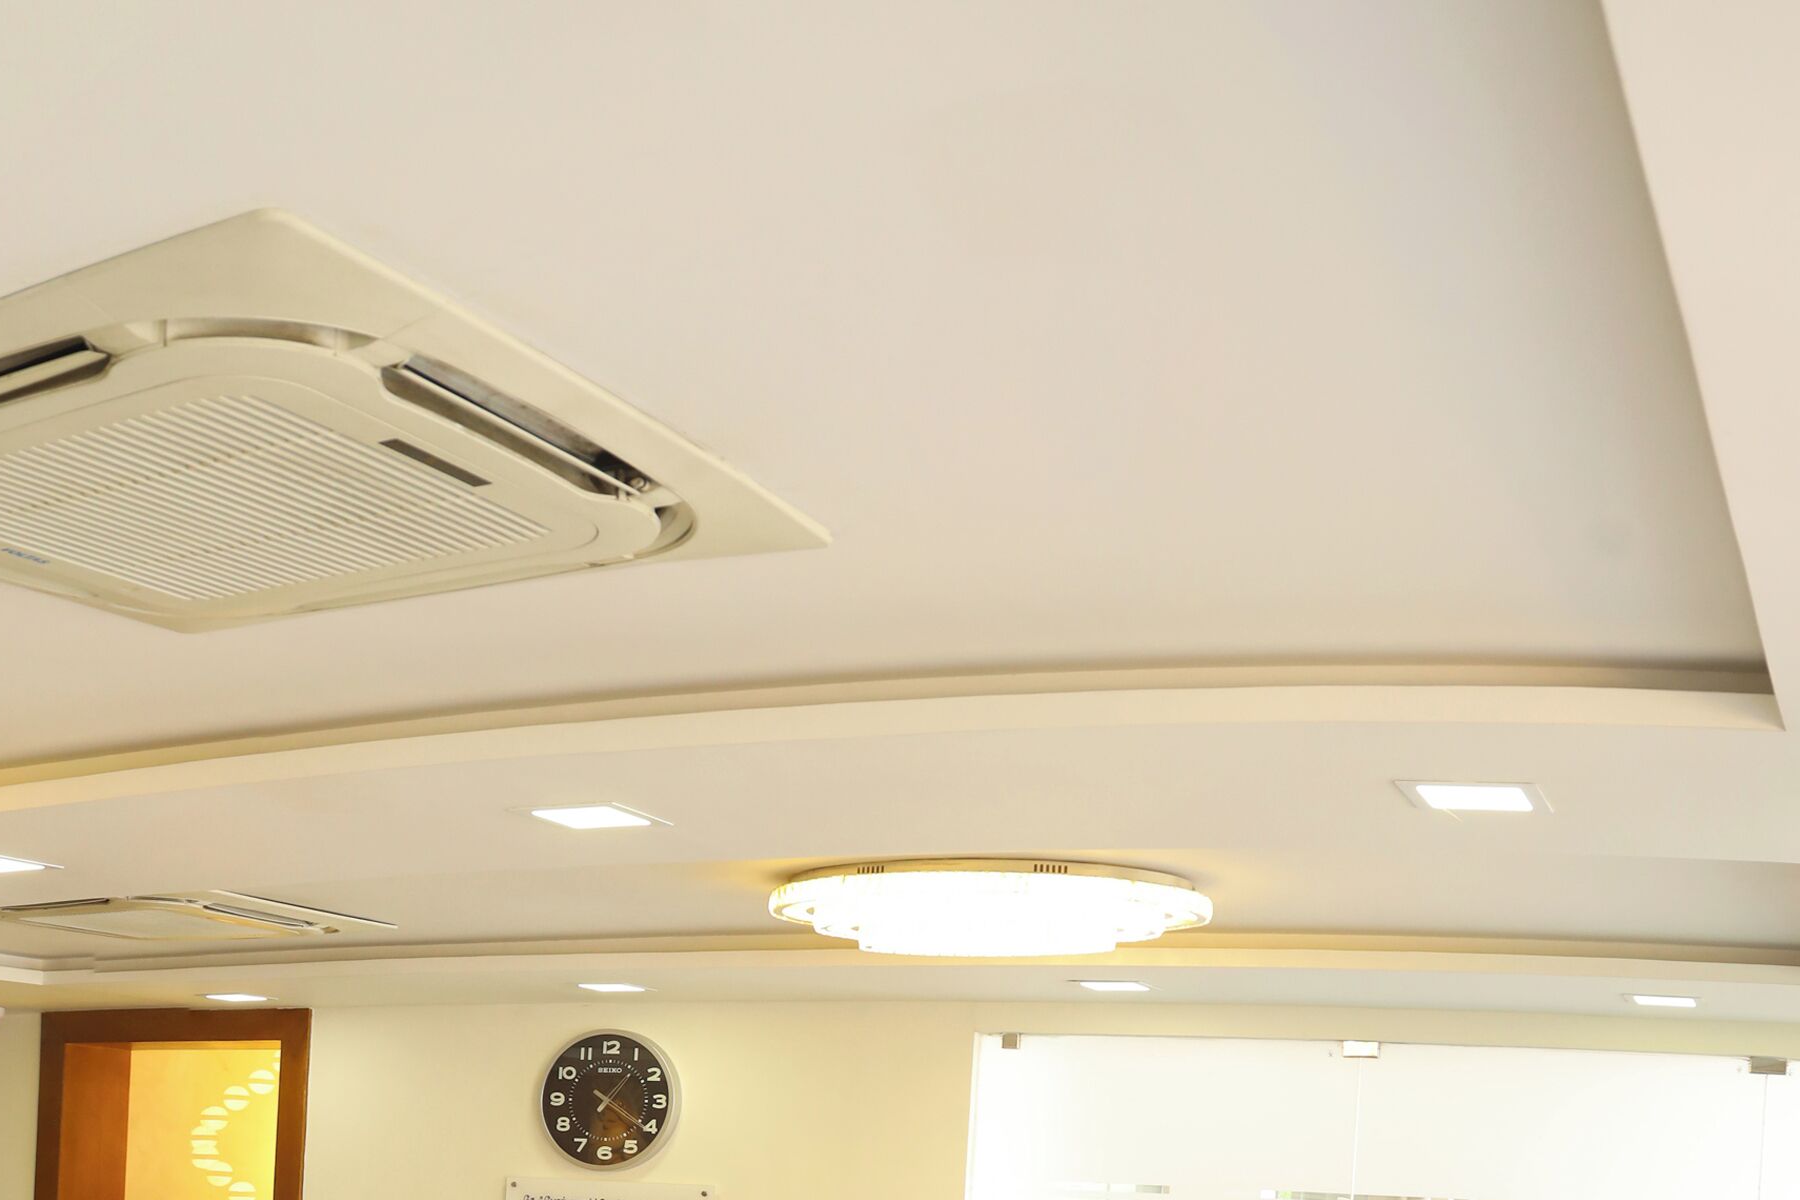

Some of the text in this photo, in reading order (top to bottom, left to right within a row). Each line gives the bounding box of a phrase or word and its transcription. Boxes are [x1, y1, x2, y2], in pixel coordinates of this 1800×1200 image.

[580, 1047, 592, 1060] 11
[603, 1040, 620, 1055] 12
[634, 1048, 640, 1061] 1
[558, 1066, 576, 1080] 10
[647, 1067, 662, 1082] 2
[550, 1092, 565, 1106] 9
[652, 1094, 667, 1109] 3
[556, 1117, 570, 1131] 8
[643, 1119, 658, 1134] 4
[573, 1138, 588, 1152] 7
[623, 1140, 638, 1154] 5
[596, 1146, 613, 1160] 6
